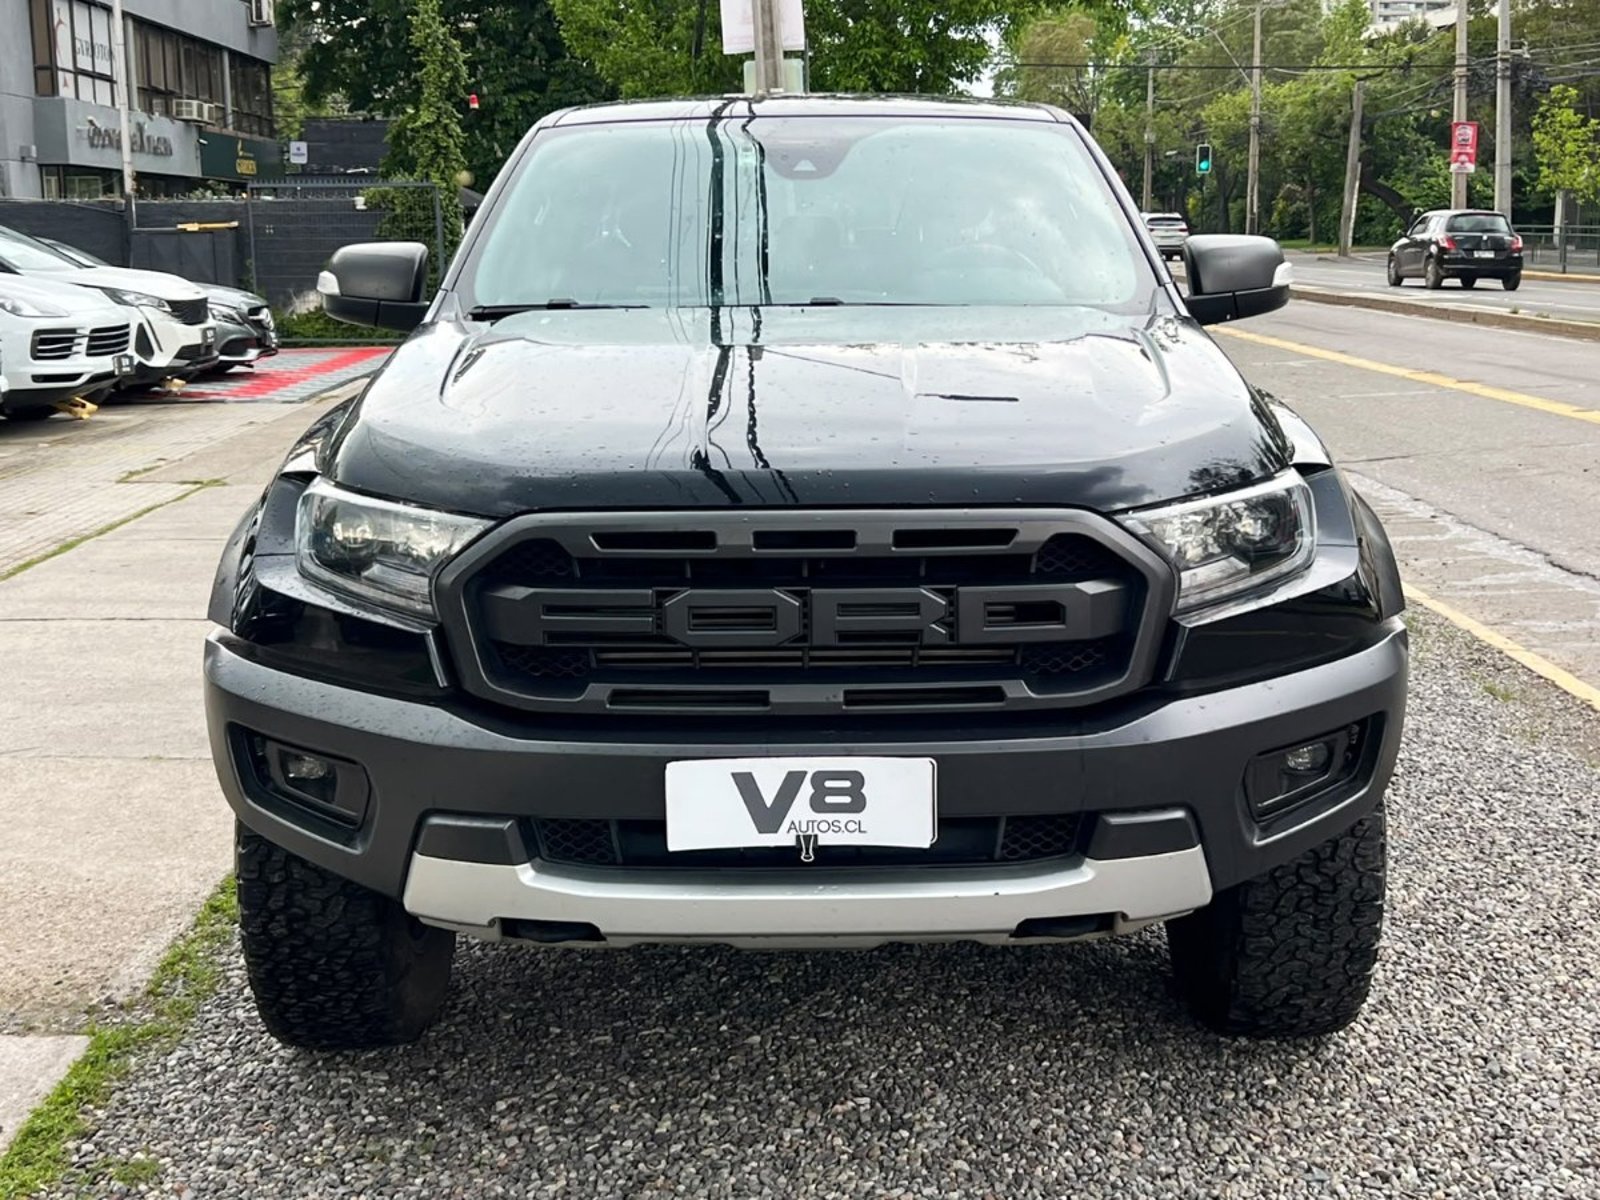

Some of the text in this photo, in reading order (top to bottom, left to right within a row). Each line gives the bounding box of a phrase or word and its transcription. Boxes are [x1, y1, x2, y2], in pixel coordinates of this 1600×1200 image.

[490, 581, 1122, 647] FORD
[731, 770, 867, 834] V8
[786, 819, 868, 834] AUTOS.CL
